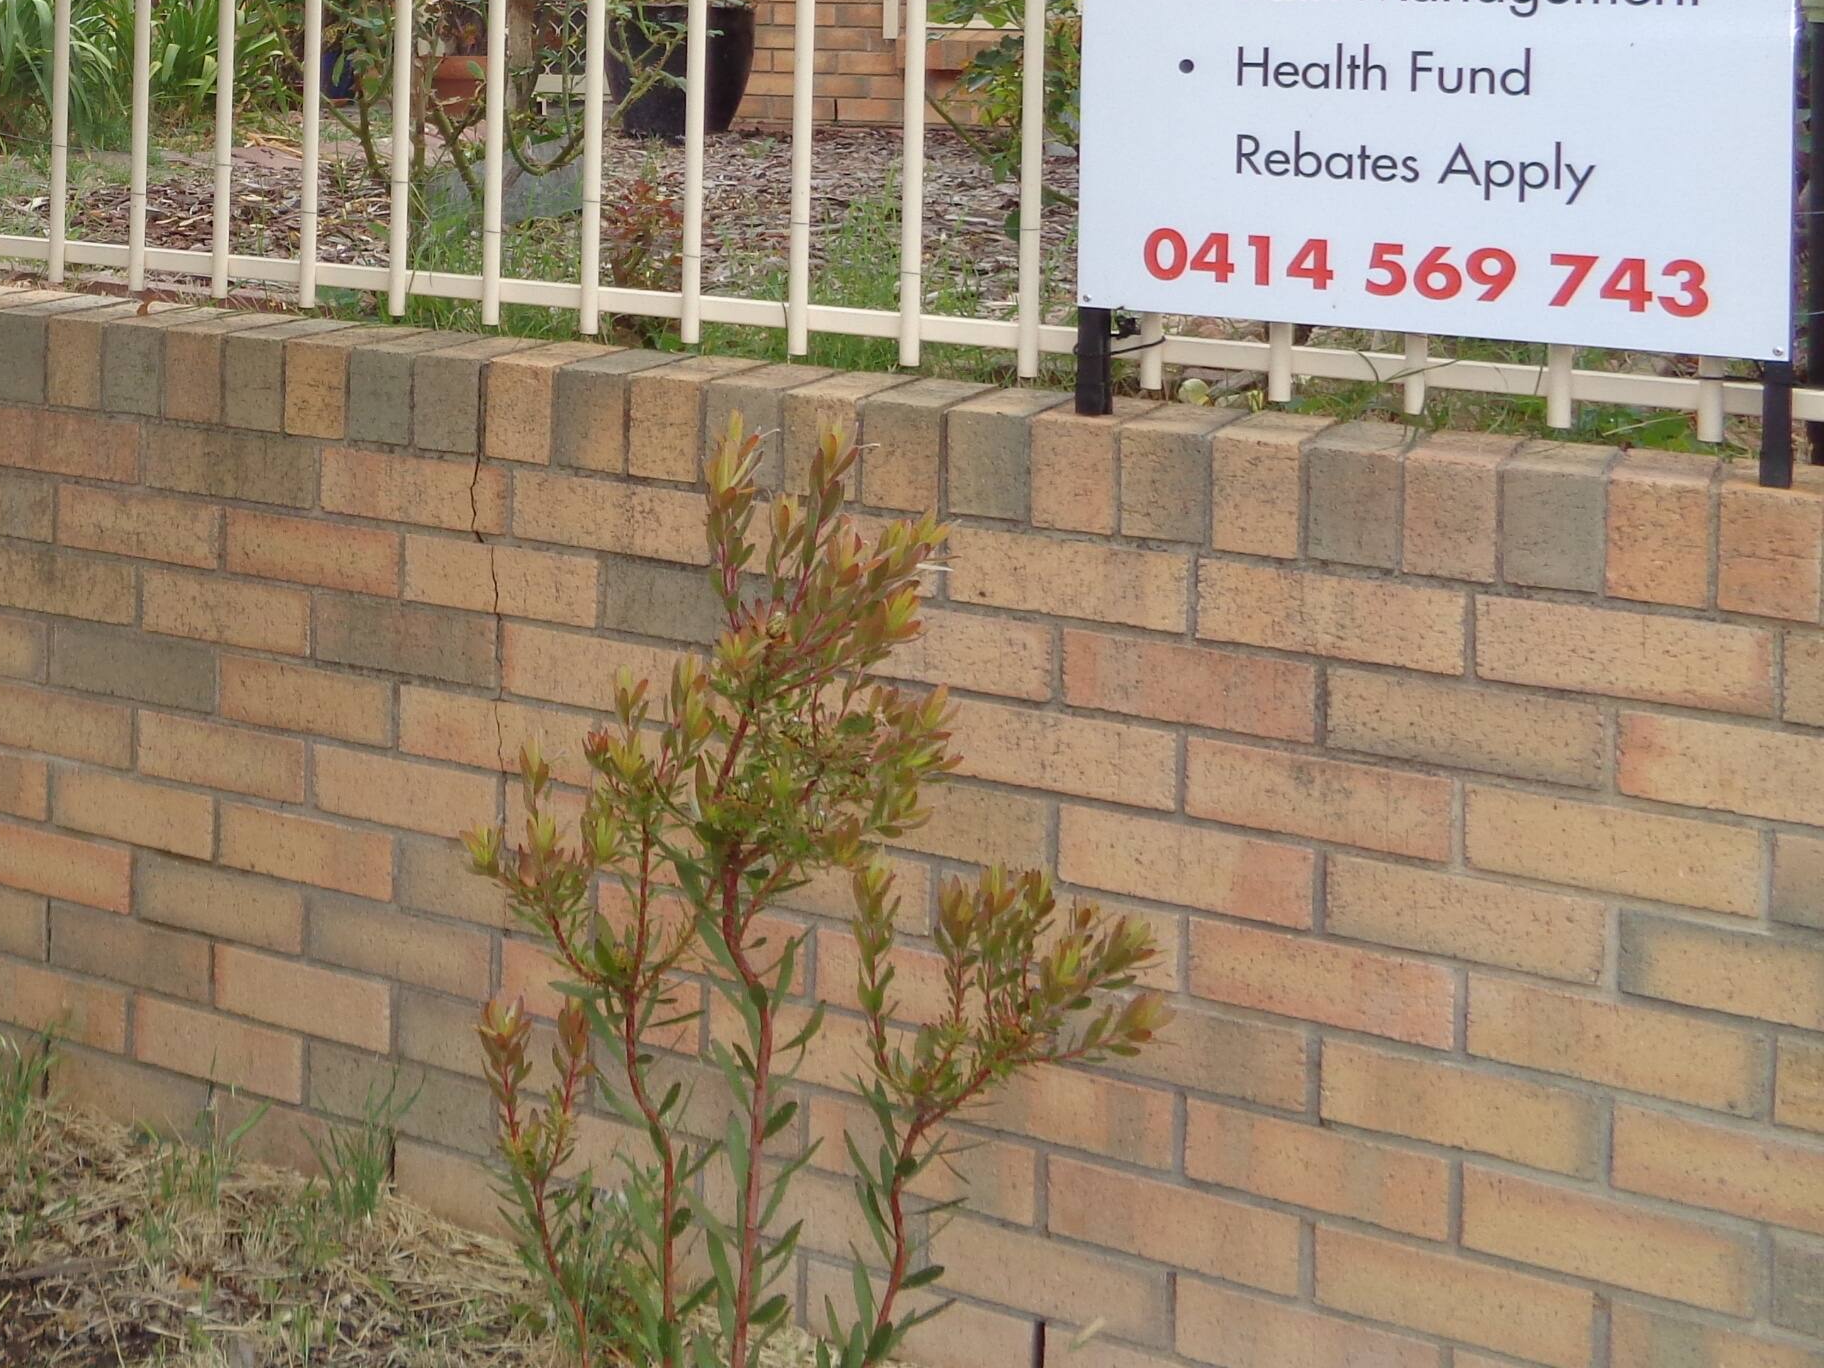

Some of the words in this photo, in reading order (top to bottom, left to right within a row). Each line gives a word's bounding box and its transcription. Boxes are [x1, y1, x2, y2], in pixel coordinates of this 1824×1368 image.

[1236, 42, 1387, 91] Health
[1409, 47, 1532, 96] Fund
[1235, 130, 1421, 183] Rebates
[1437, 141, 1596, 206] Apply
[1143, 227, 1334, 291] 0414
[1364, 242, 1517, 302] 569
[1547, 253, 1709, 318] 743
